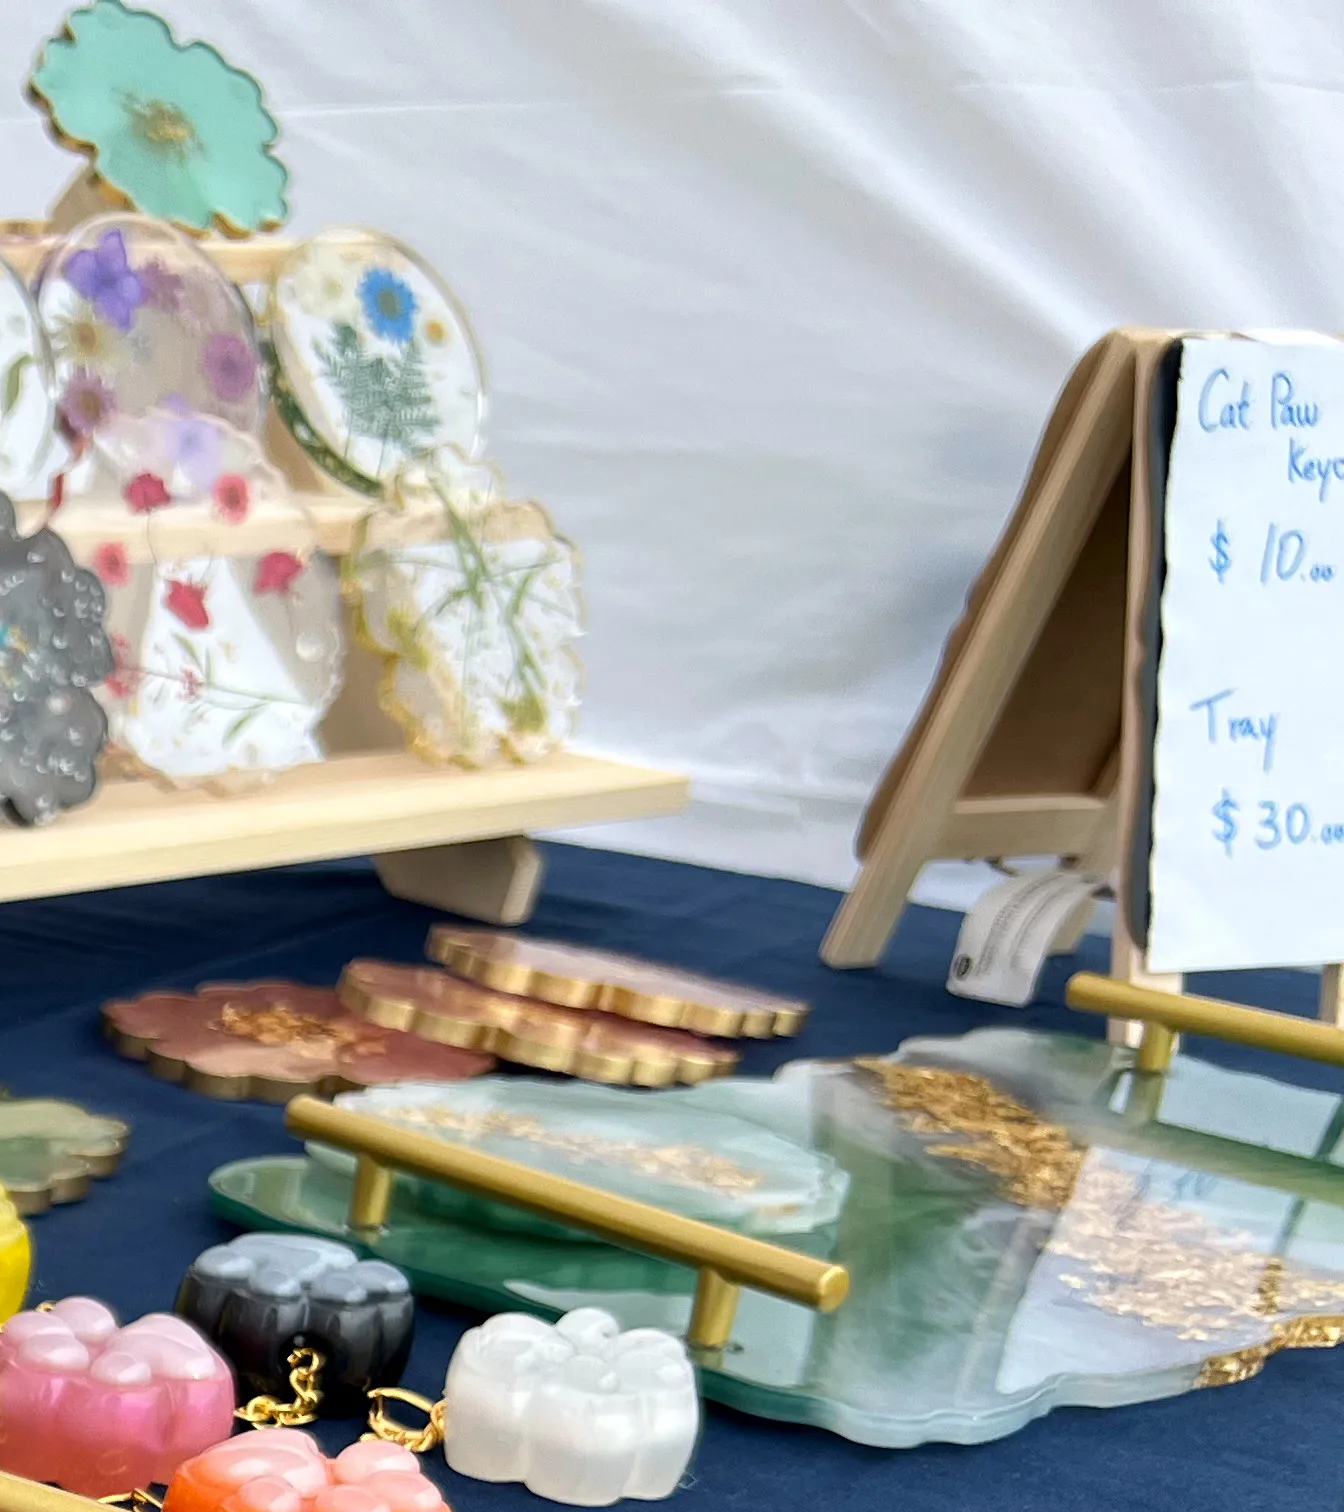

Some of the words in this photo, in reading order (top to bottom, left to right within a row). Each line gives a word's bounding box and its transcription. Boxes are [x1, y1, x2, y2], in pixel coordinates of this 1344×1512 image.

[1198, 367, 1250, 433] Cat
[1270, 370, 1319, 431] Paw
[1189, 687, 1281, 772] Tray
